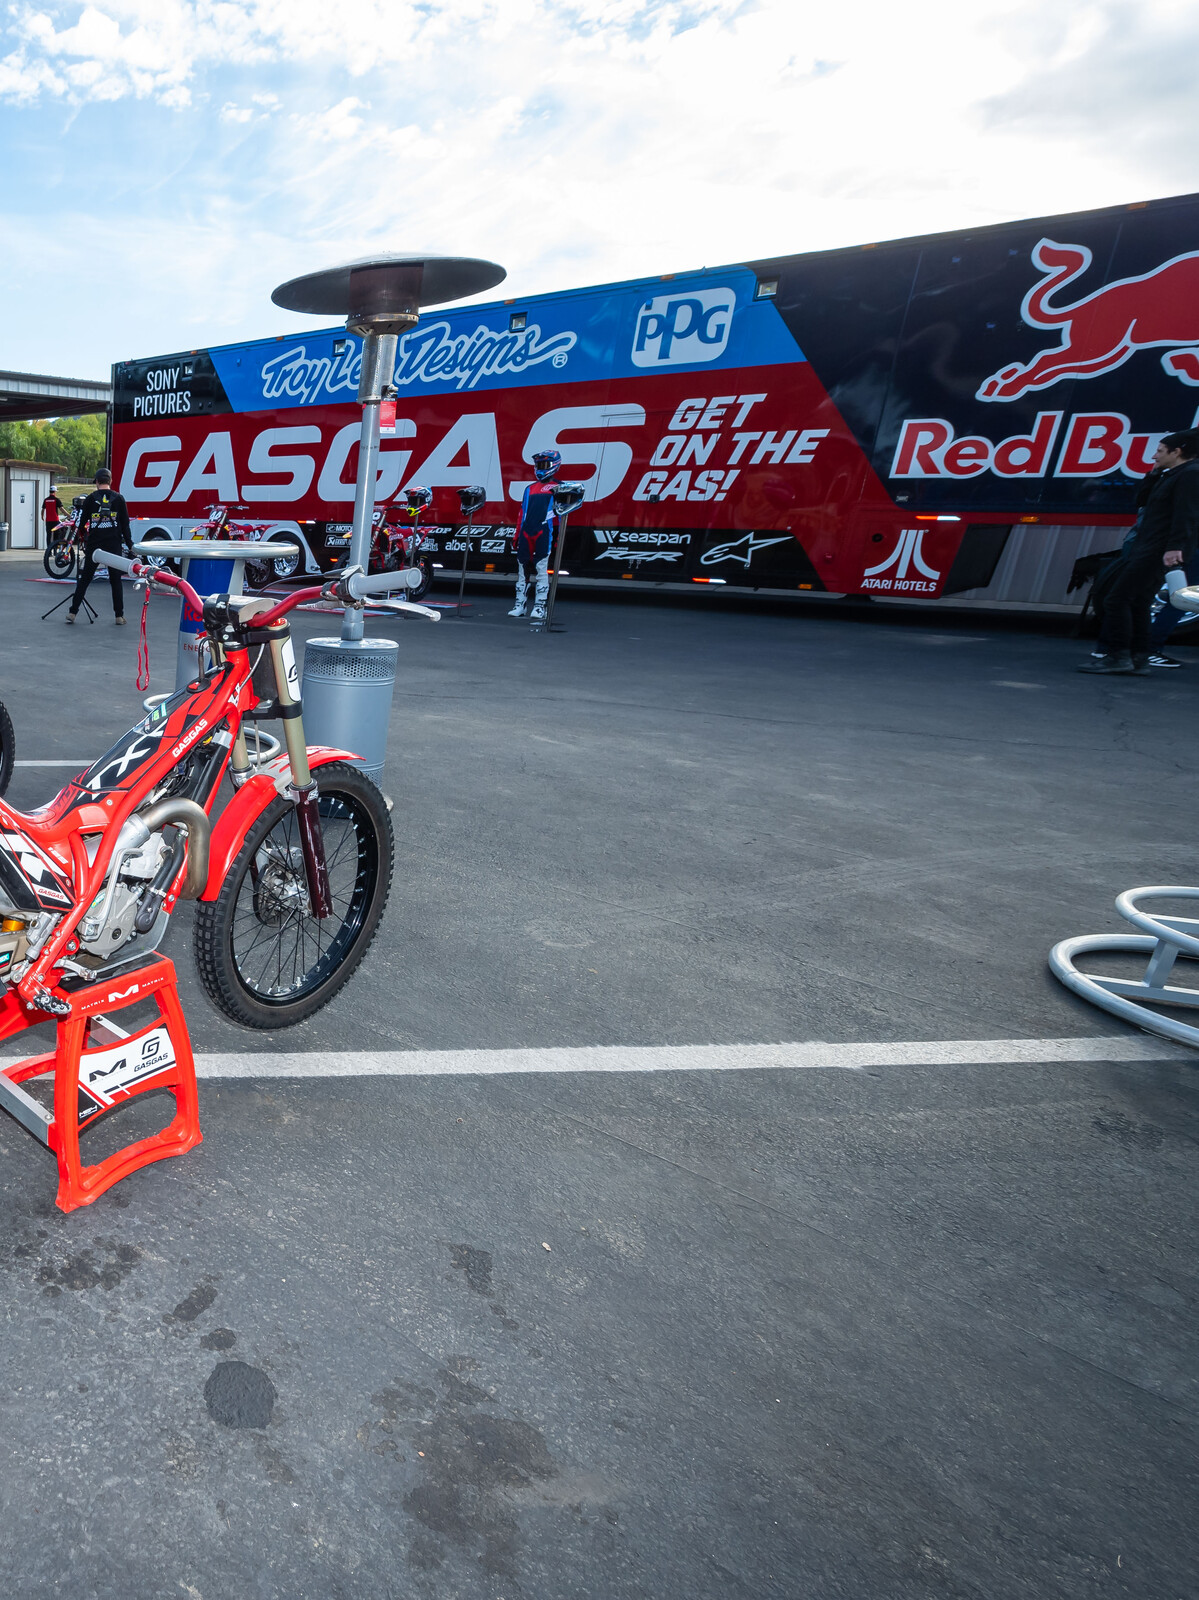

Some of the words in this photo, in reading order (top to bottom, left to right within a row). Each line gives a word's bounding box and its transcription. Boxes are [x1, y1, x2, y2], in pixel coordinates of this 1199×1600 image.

[262, 345, 327, 404] Troy
[325, 340, 360, 393] Le
[395, 321, 577, 389] Designs
[146, 367, 180, 392] SONY
[133, 390, 191, 418] PICTURES
[668, 393, 767, 430] GET
[120, 404, 647, 502] GASGAS
[650, 432, 721, 467] ON
[727, 429, 830, 465] THE
[890, 410, 1062, 479] Red
[1054, 410, 1172, 479] Bu
[633, 468, 740, 502] GAS!
[445, 539, 474, 551] albek
[618, 532, 692, 546] seaspan
[594, 550, 684, 562] RZR
[860, 578, 893, 590] ATARI
[894, 580, 937, 592] HOTELS
[184, 602, 204, 622] Re
[172, 718, 208, 758] GASGAS
[38, 887, 64, 901] GASGAS
[81, 999, 105, 1011] MATRIX
[141, 977, 164, 988] MATRIX
[133, 1052, 169, 1073] GASGAS
